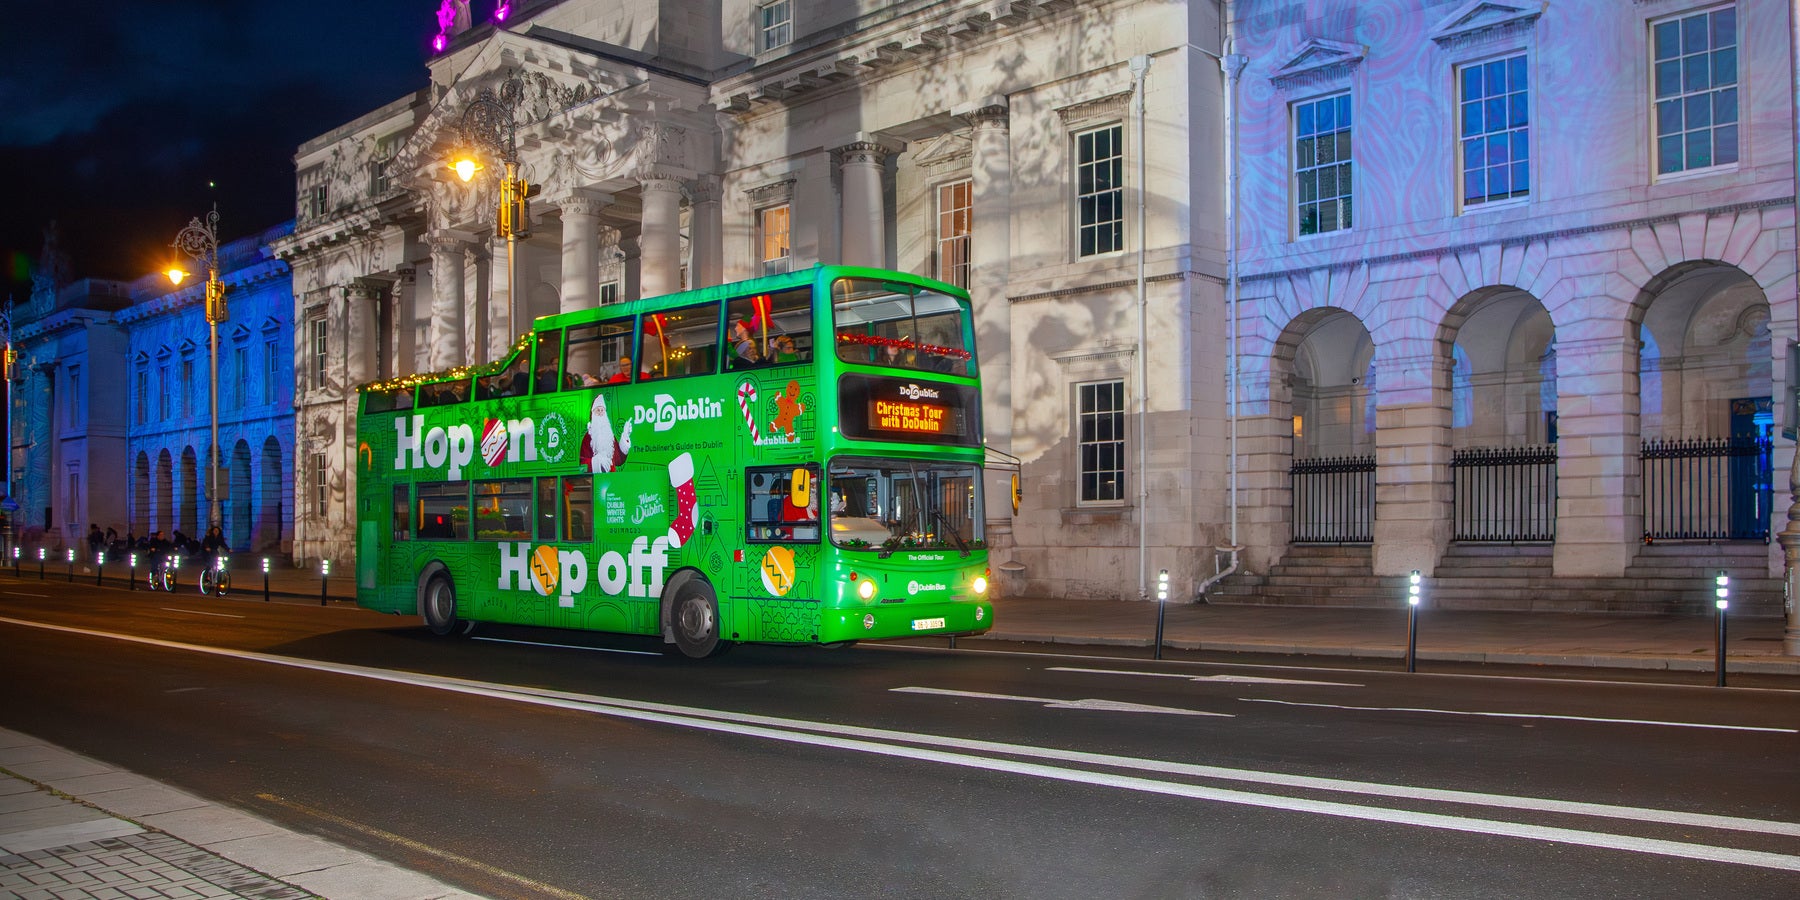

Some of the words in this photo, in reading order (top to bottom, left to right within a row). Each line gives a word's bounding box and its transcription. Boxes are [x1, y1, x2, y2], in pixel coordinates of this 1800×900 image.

[899, 384, 939, 399] DoDublin
[634, 394, 722, 432] DoDublin
[876, 401, 920, 417] Christmas
[923, 406, 943, 419] Tour
[557, 413, 568, 436] TOUR
[881, 415, 900, 428] with
[902, 416, 939, 431] DoDublin
[394, 414, 474, 481] Hop
[634, 445, 644, 453] The
[645, 443, 675, 453] Dubliner's
[676, 442, 693, 451] Guide
[702, 441, 723, 449] Dublin
[607, 501, 625, 509] DUBLIN
[607, 508, 626, 516] WINTER
[607, 516, 625, 524] LIGHTS
[498, 542, 588, 607] Hop
[598, 536, 668, 598] off
